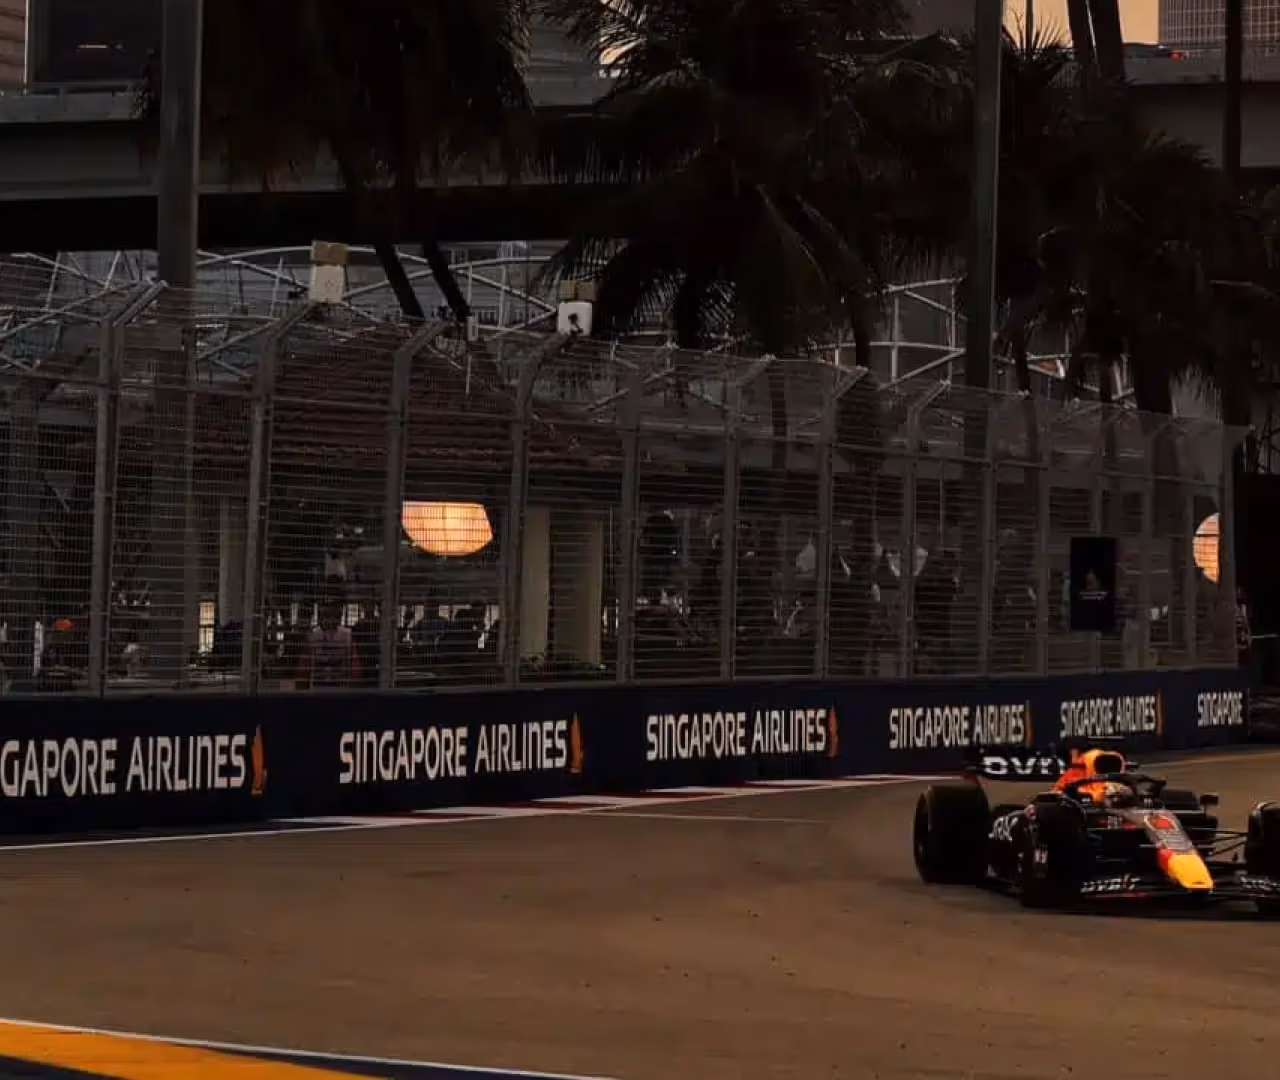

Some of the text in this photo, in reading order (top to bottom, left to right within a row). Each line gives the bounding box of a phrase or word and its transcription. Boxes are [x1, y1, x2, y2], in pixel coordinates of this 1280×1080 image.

[645, 708, 826, 761] SINGAPORE AIRLINES
[889, 704, 1025, 749] SINGAPORE AIRLINES
[1060, 695, 1156, 738] SINGAPORE AIRLINES
[125, 734, 247, 792] AIRLINES
[338, 719, 567, 783] SINGAPORE AIRLINES
